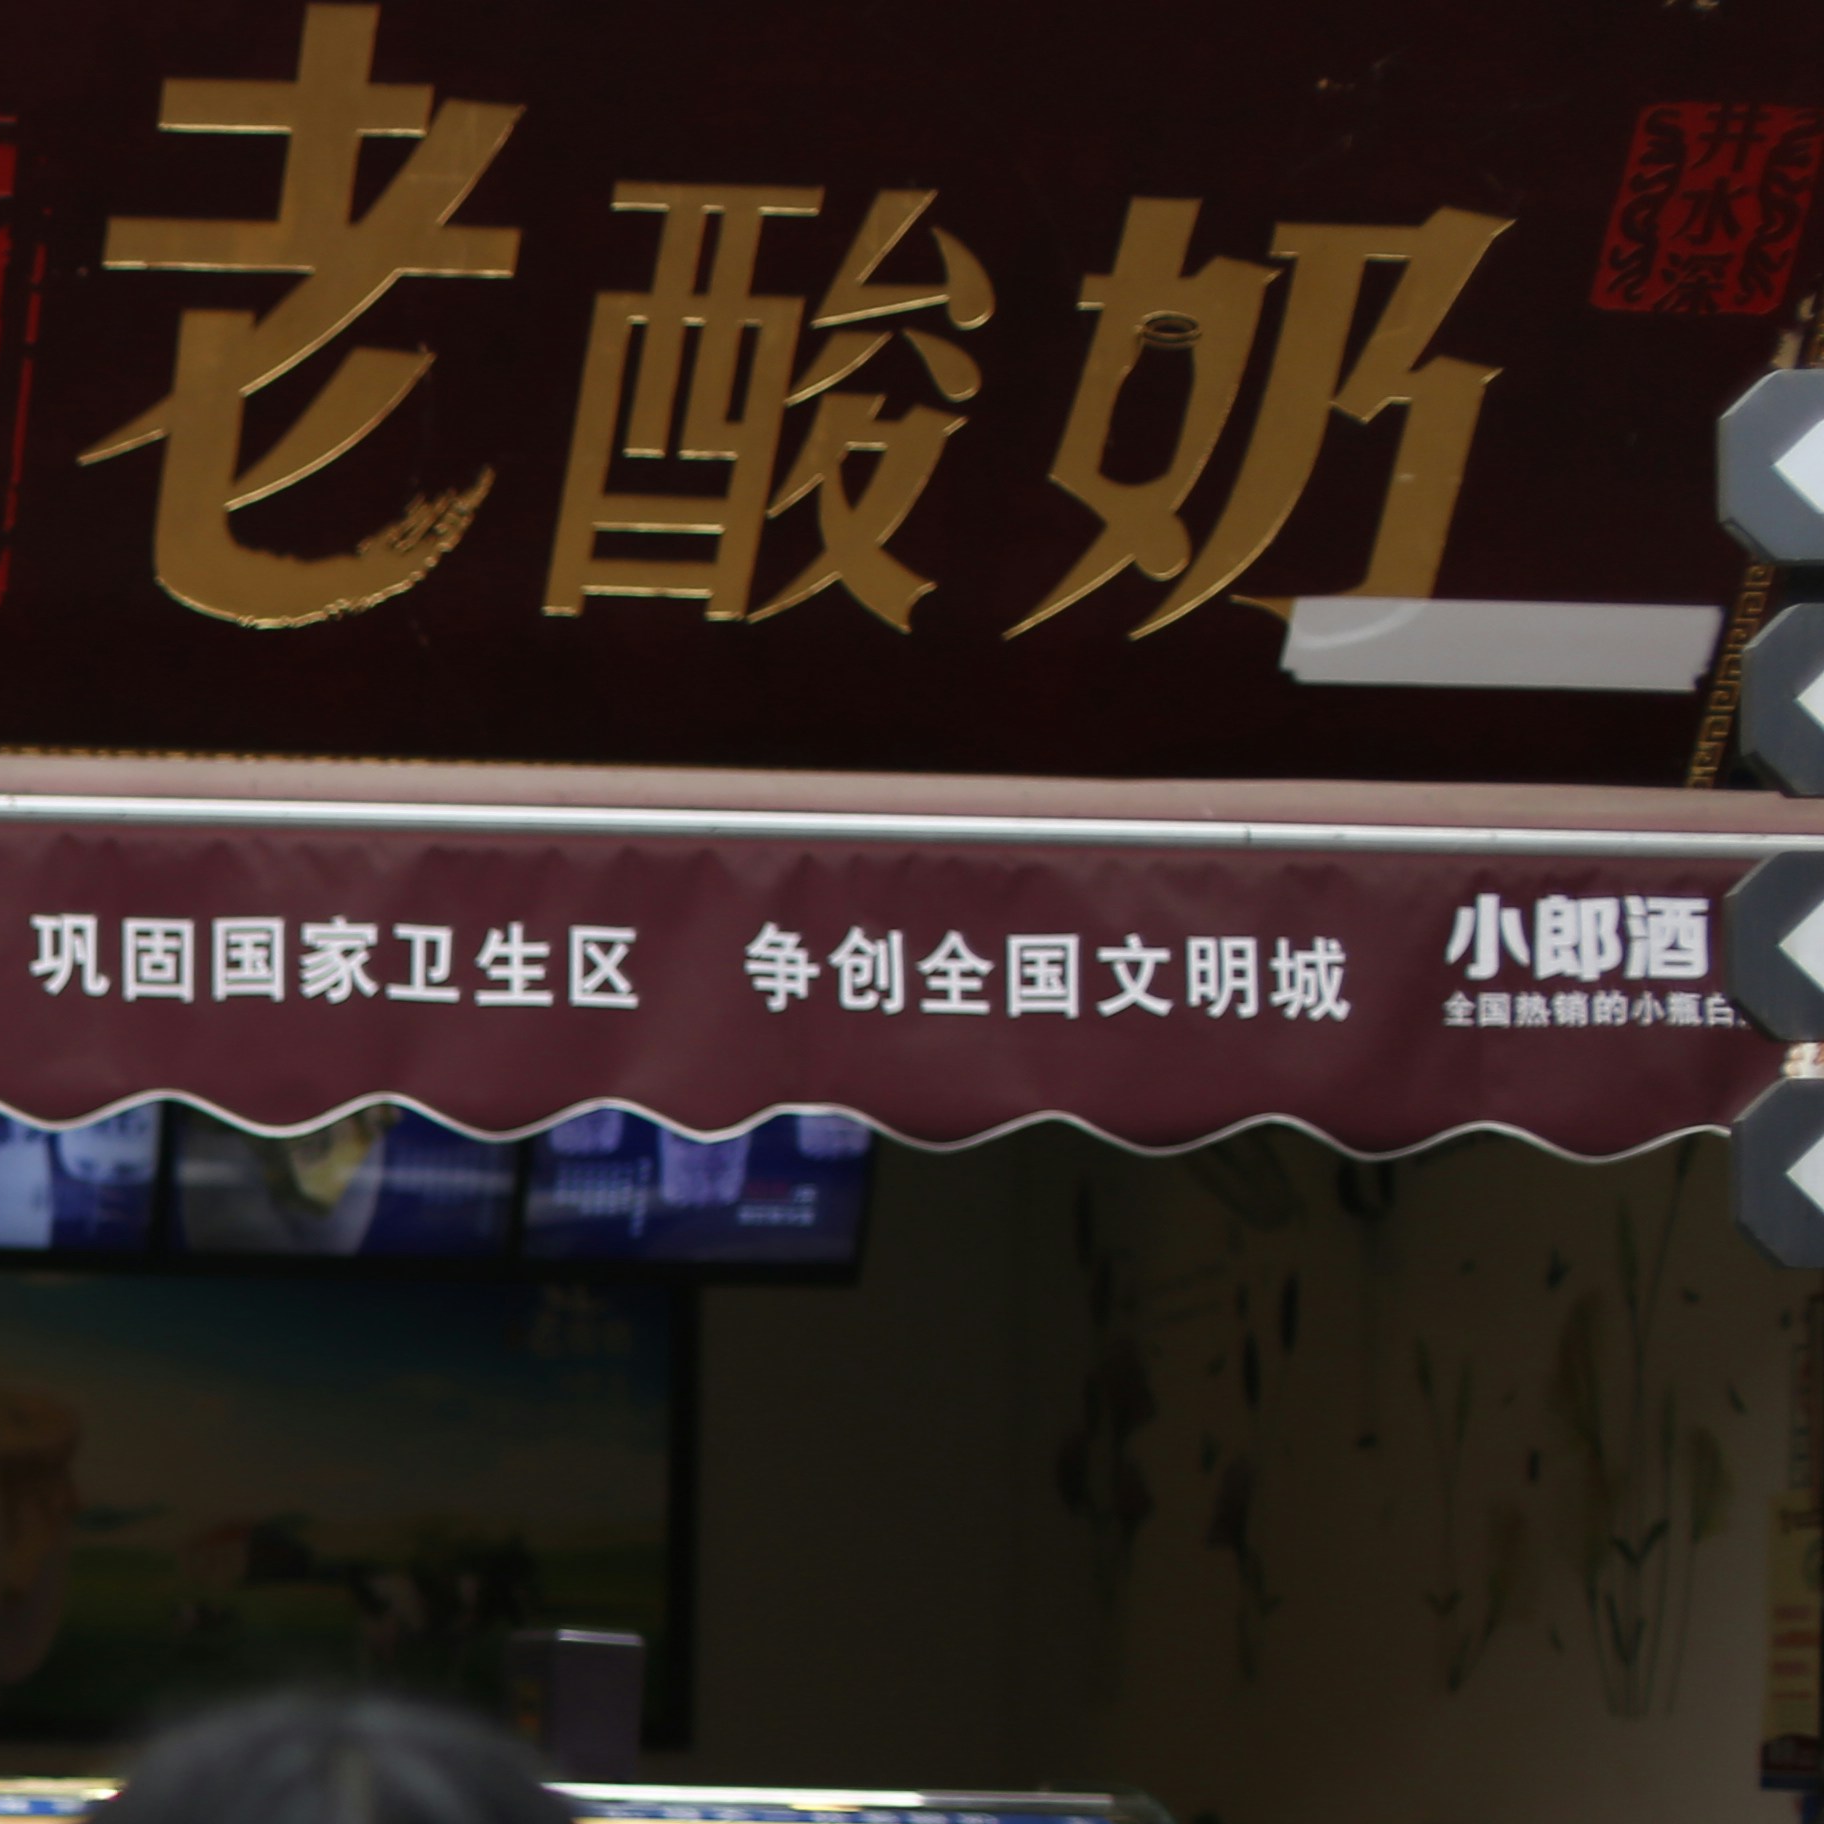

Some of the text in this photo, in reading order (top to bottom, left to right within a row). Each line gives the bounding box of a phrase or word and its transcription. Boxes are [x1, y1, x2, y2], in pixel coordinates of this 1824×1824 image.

[77, 2, 1518, 640] 老酸奶
[29, 912, 638, 1011] 巩固国家卫生区
[744, 919, 1351, 1023] 争创全国文明城
[1445, 892, 1711, 983] 小郎酒
[1441, 990, 1750, 1028] 全国热销的小瓶白
